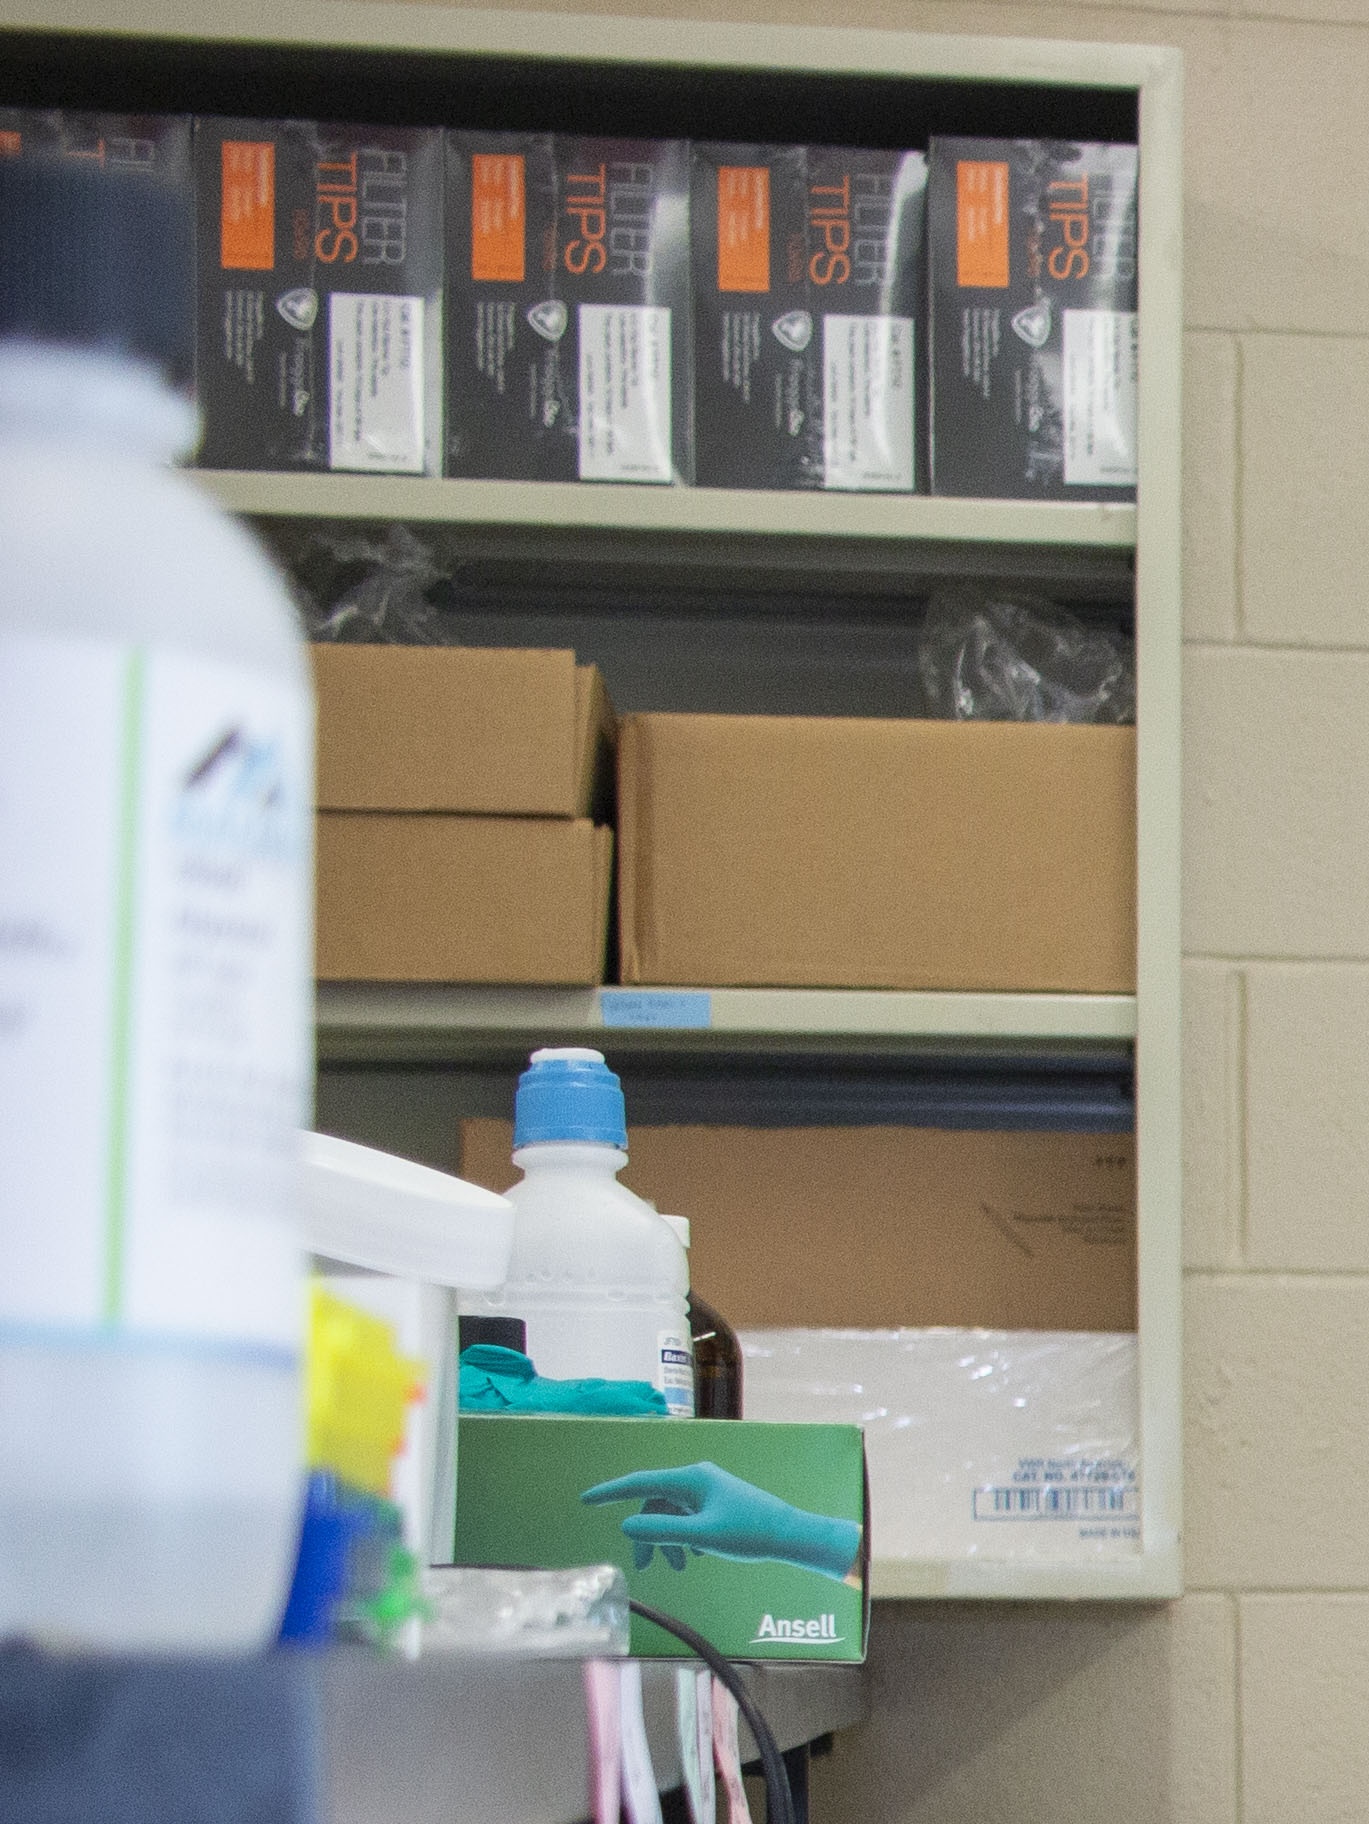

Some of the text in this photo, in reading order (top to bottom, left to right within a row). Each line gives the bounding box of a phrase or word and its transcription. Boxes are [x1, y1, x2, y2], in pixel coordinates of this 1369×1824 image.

[314, 153, 358, 264] TIPS
[564, 163, 606, 275] TIPS
[809, 176, 850, 286] TIPS
[1047, 173, 1089, 280] TIPS
[758, 1613, 837, 1638] Ansell
